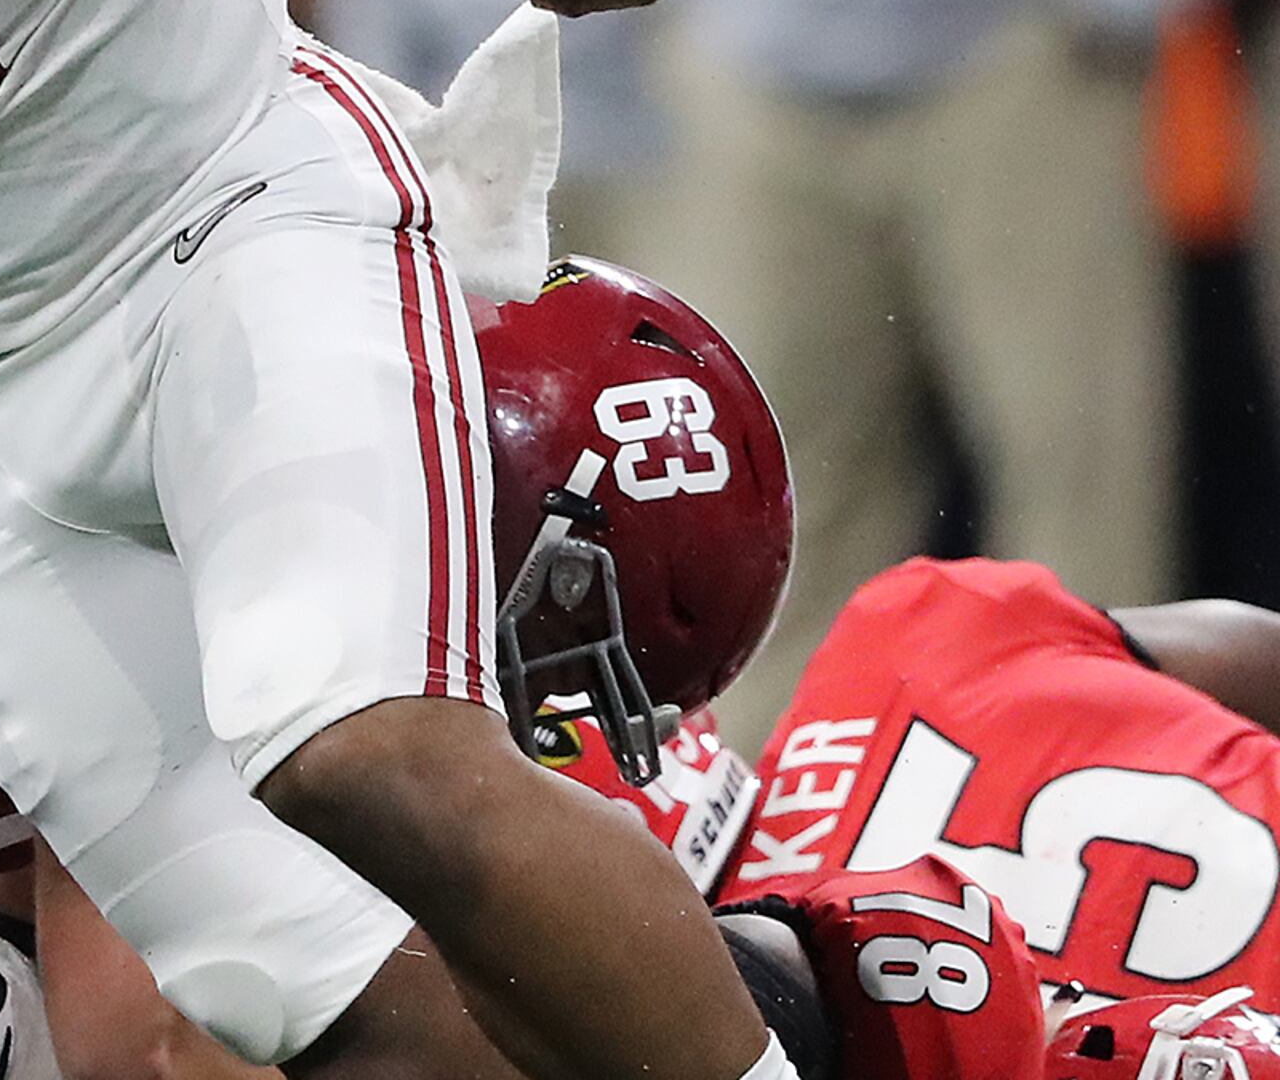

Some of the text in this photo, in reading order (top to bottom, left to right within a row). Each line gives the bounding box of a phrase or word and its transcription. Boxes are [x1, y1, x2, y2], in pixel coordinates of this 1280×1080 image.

[593, 377, 731, 502] 63
[844, 715, 1280, 995] 5
[850, 882, 992, 1014] 78
